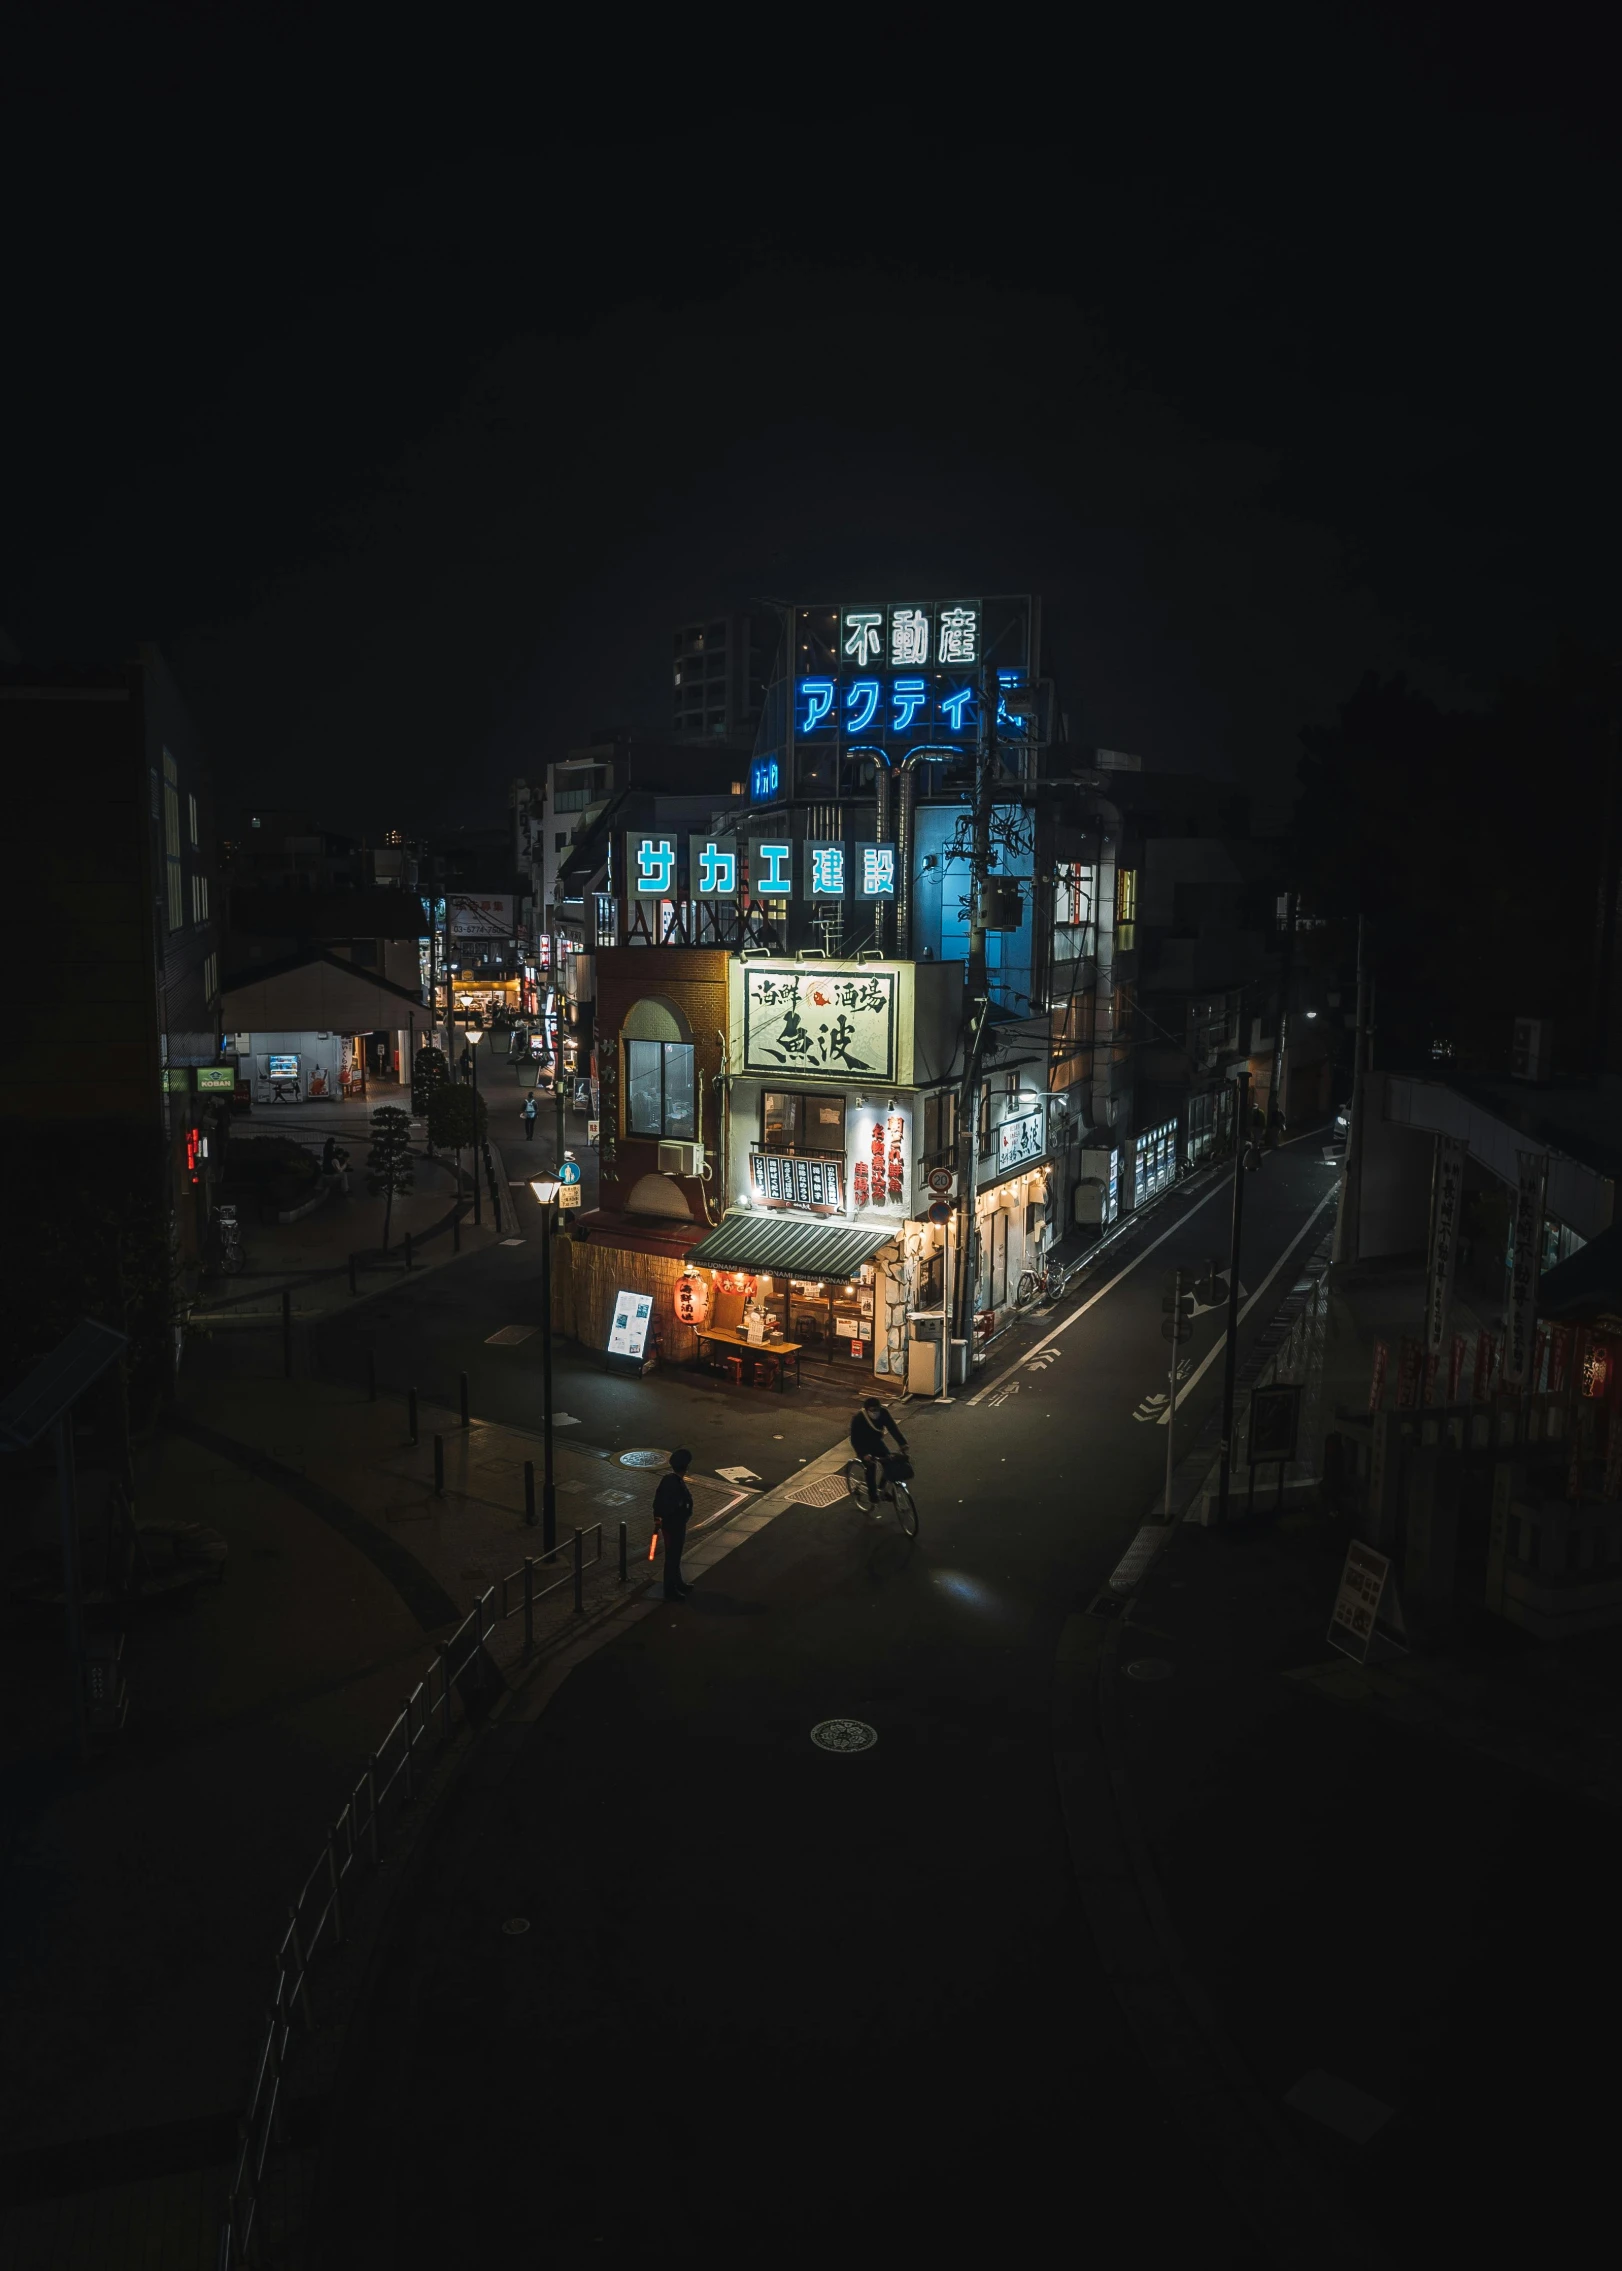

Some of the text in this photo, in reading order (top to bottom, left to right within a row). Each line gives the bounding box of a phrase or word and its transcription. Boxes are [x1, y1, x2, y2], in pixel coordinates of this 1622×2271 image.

[844, 608, 976, 667] 不動産
[637, 838, 895, 896] サカエ建設
[751, 975, 888, 1014] 海鮮 酒場
[758, 1010, 876, 1071] 魚波
[201, 1080, 231, 1088] KOBAN
[854, 1161, 868, 1207] 串揚げ
[934, 1174, 948, 1186] 20
[708, 1261, 738, 1271] UONAMI
[762, 1269, 794, 1279] UONAMI
[818, 1276, 850, 1286] UONAMI
[723, 1278, 756, 1294] おでん
